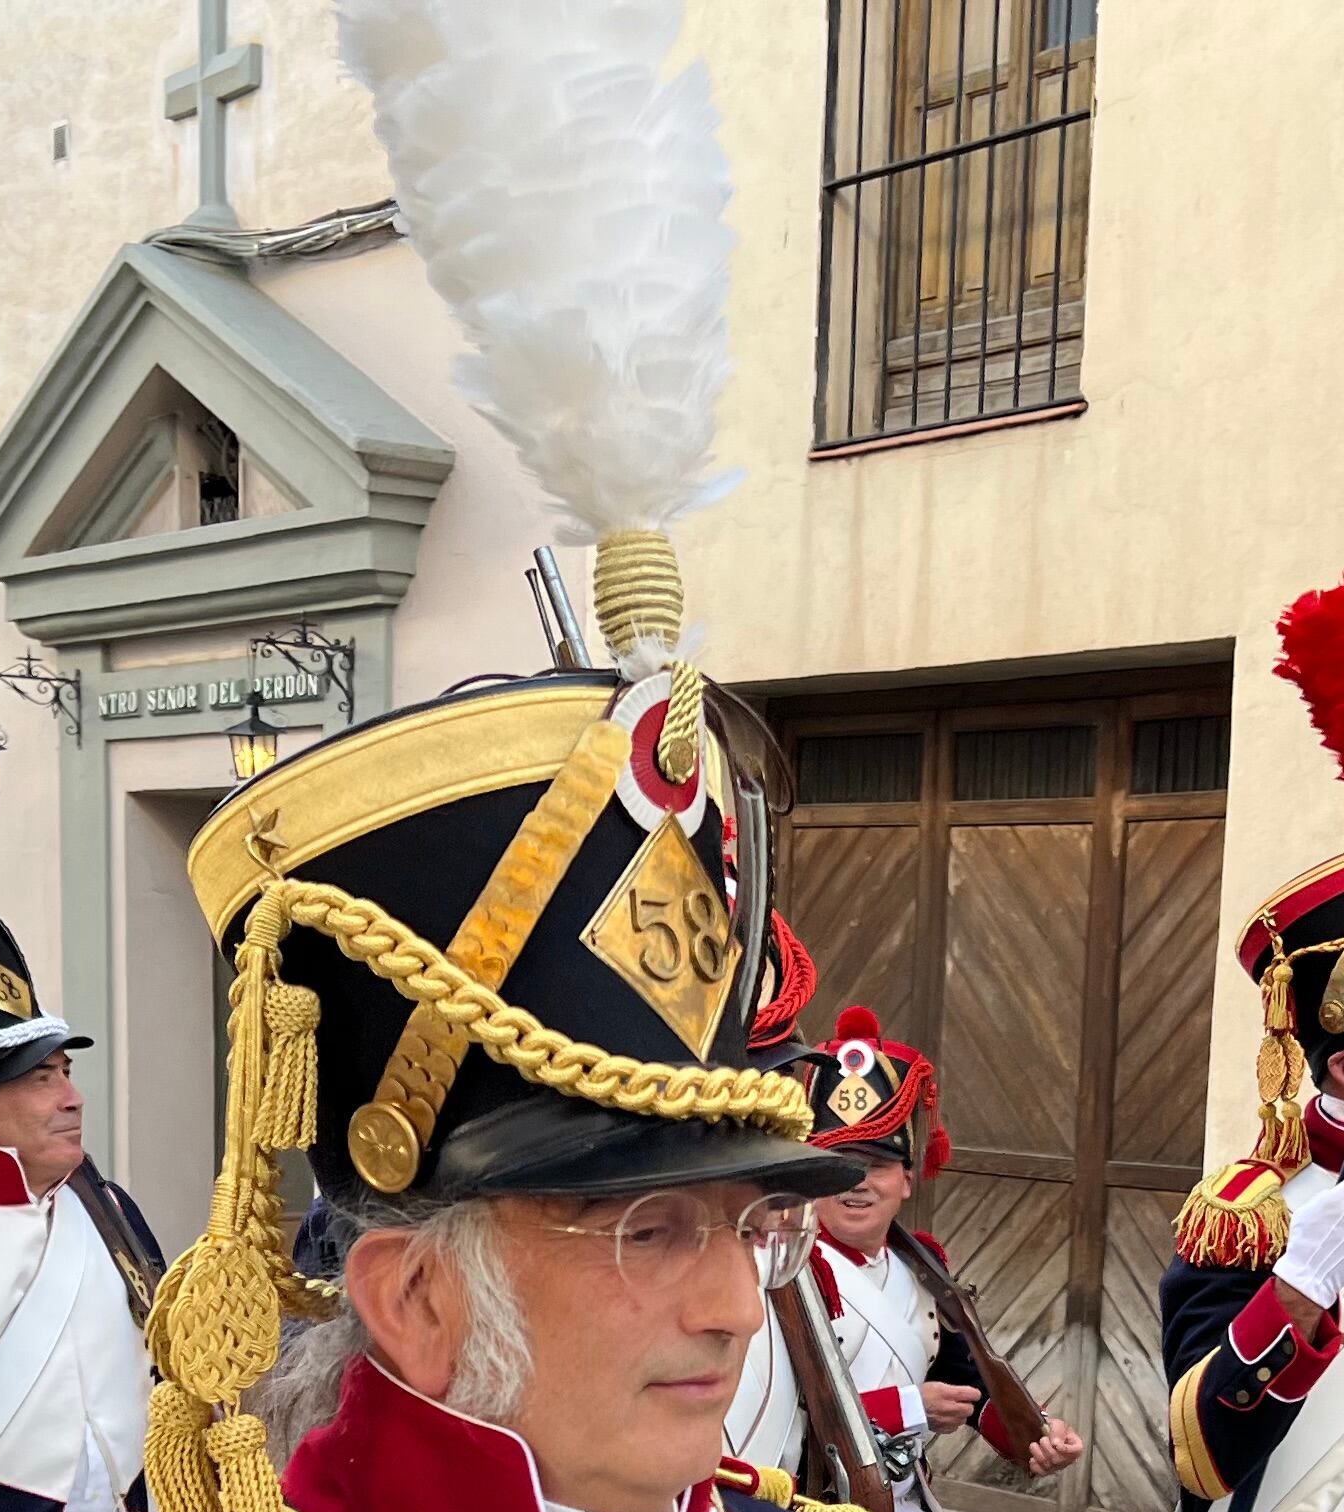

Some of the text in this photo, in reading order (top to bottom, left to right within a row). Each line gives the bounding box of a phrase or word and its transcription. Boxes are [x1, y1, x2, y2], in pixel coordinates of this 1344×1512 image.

[146, 682, 197, 712] SEÑOR
[208, 680, 240, 706] DEL
[629, 888, 725, 984] 58
[838, 1087, 867, 1111] 58
